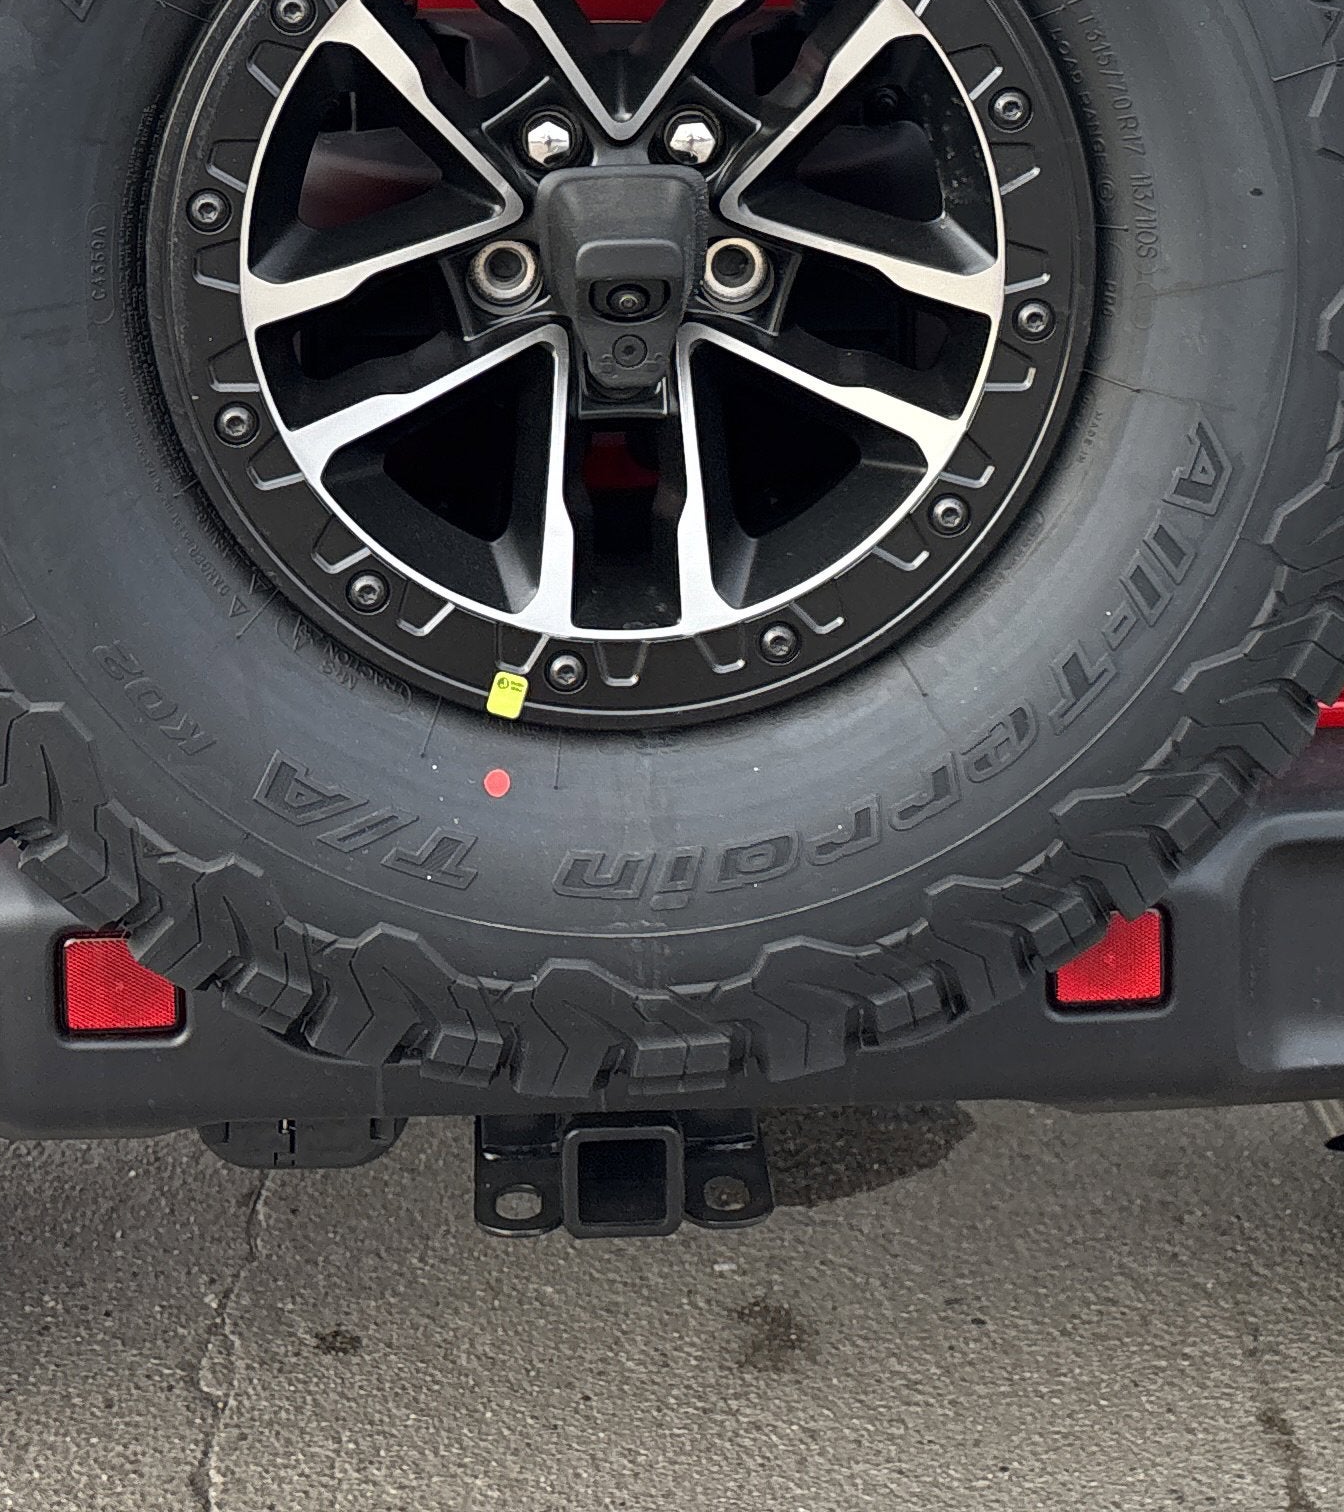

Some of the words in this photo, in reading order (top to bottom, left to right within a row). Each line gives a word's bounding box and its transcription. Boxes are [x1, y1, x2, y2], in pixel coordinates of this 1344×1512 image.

[1129, 172, 1158, 260] 113/110S
[92, 640, 217, 756] KO2
[552, 405, 1235, 911] All-Terrain
[252, 749, 479, 890] T/A
